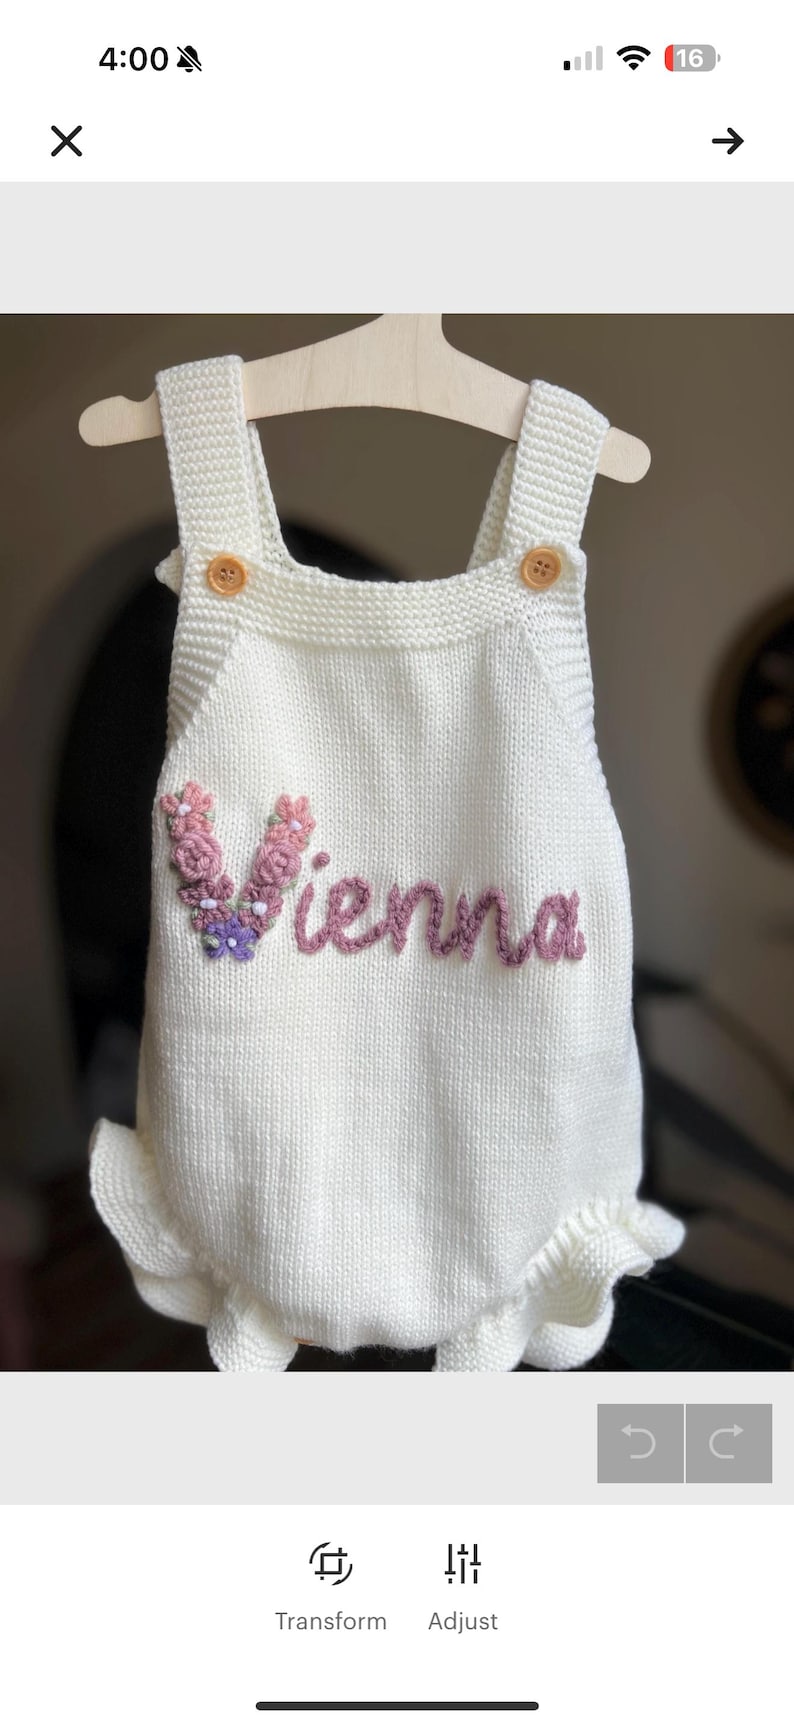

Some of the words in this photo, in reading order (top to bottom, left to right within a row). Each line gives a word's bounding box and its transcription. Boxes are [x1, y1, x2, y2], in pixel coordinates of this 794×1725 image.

[98, 46, 169, 71] 4:00
[676, 48, 704, 68] 16
[160, 780, 586, 967] Vienna
[274, 1610, 387, 1630] Transform
[428, 1610, 498, 1634] Adjust
